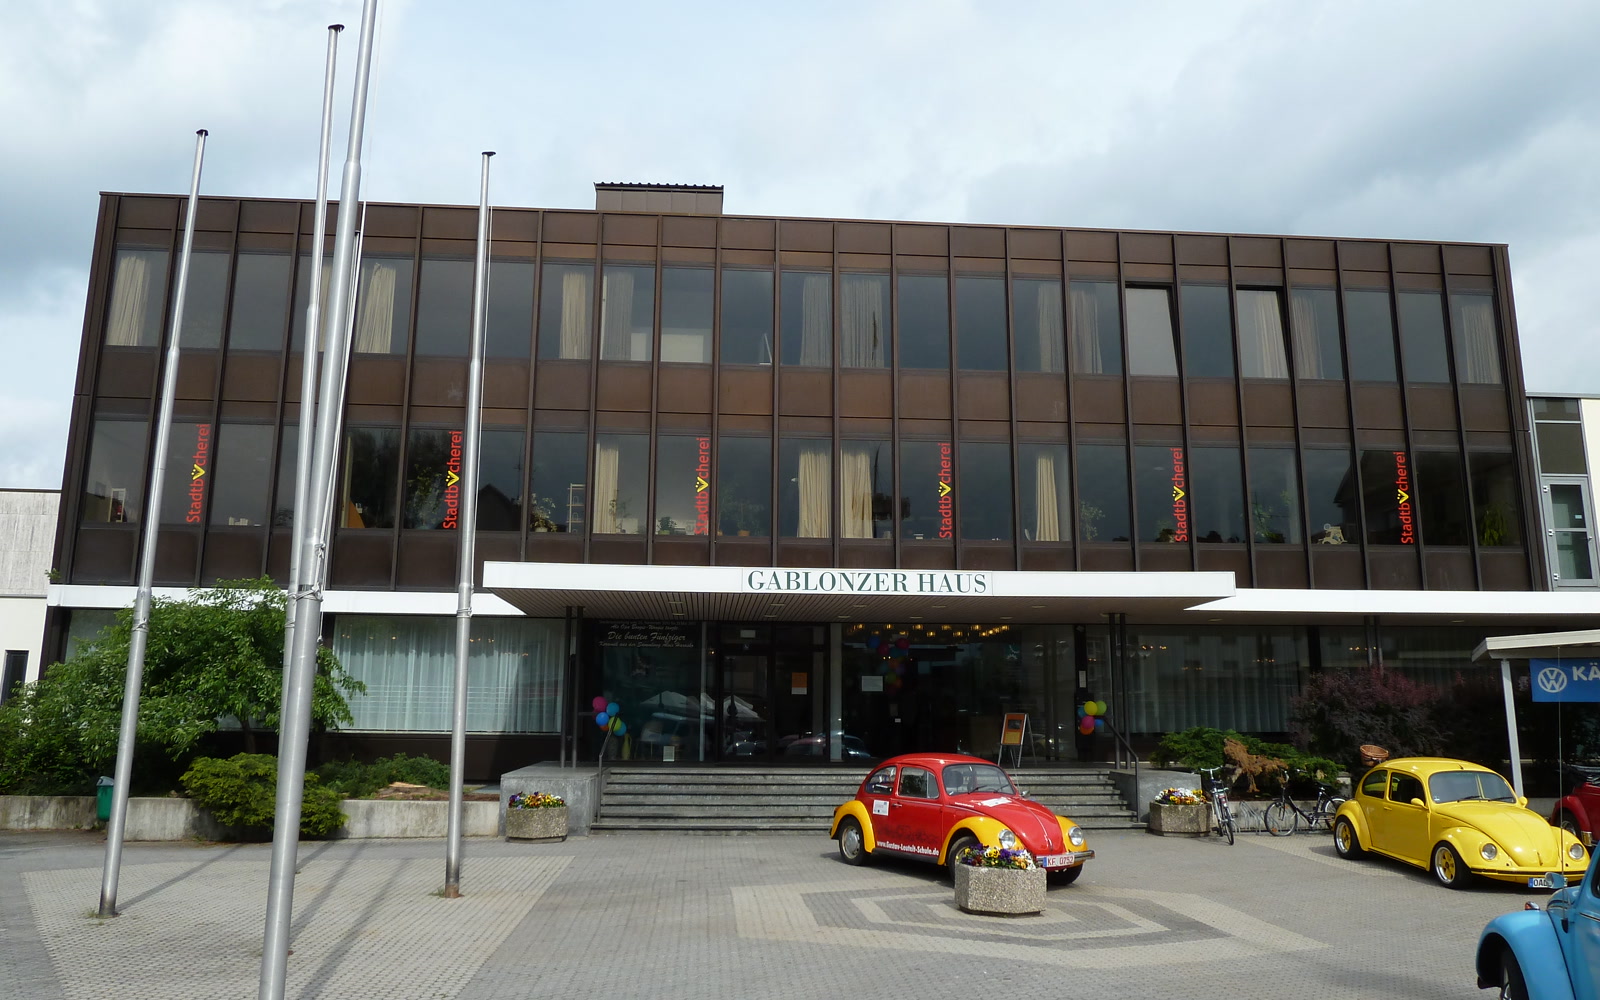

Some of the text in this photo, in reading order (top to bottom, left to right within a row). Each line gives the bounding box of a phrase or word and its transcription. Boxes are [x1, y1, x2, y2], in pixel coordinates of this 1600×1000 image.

[747, 570, 987, 593] GABLONZER HAUS
[607, 631, 686, 643] Die bunten Fünfziger
